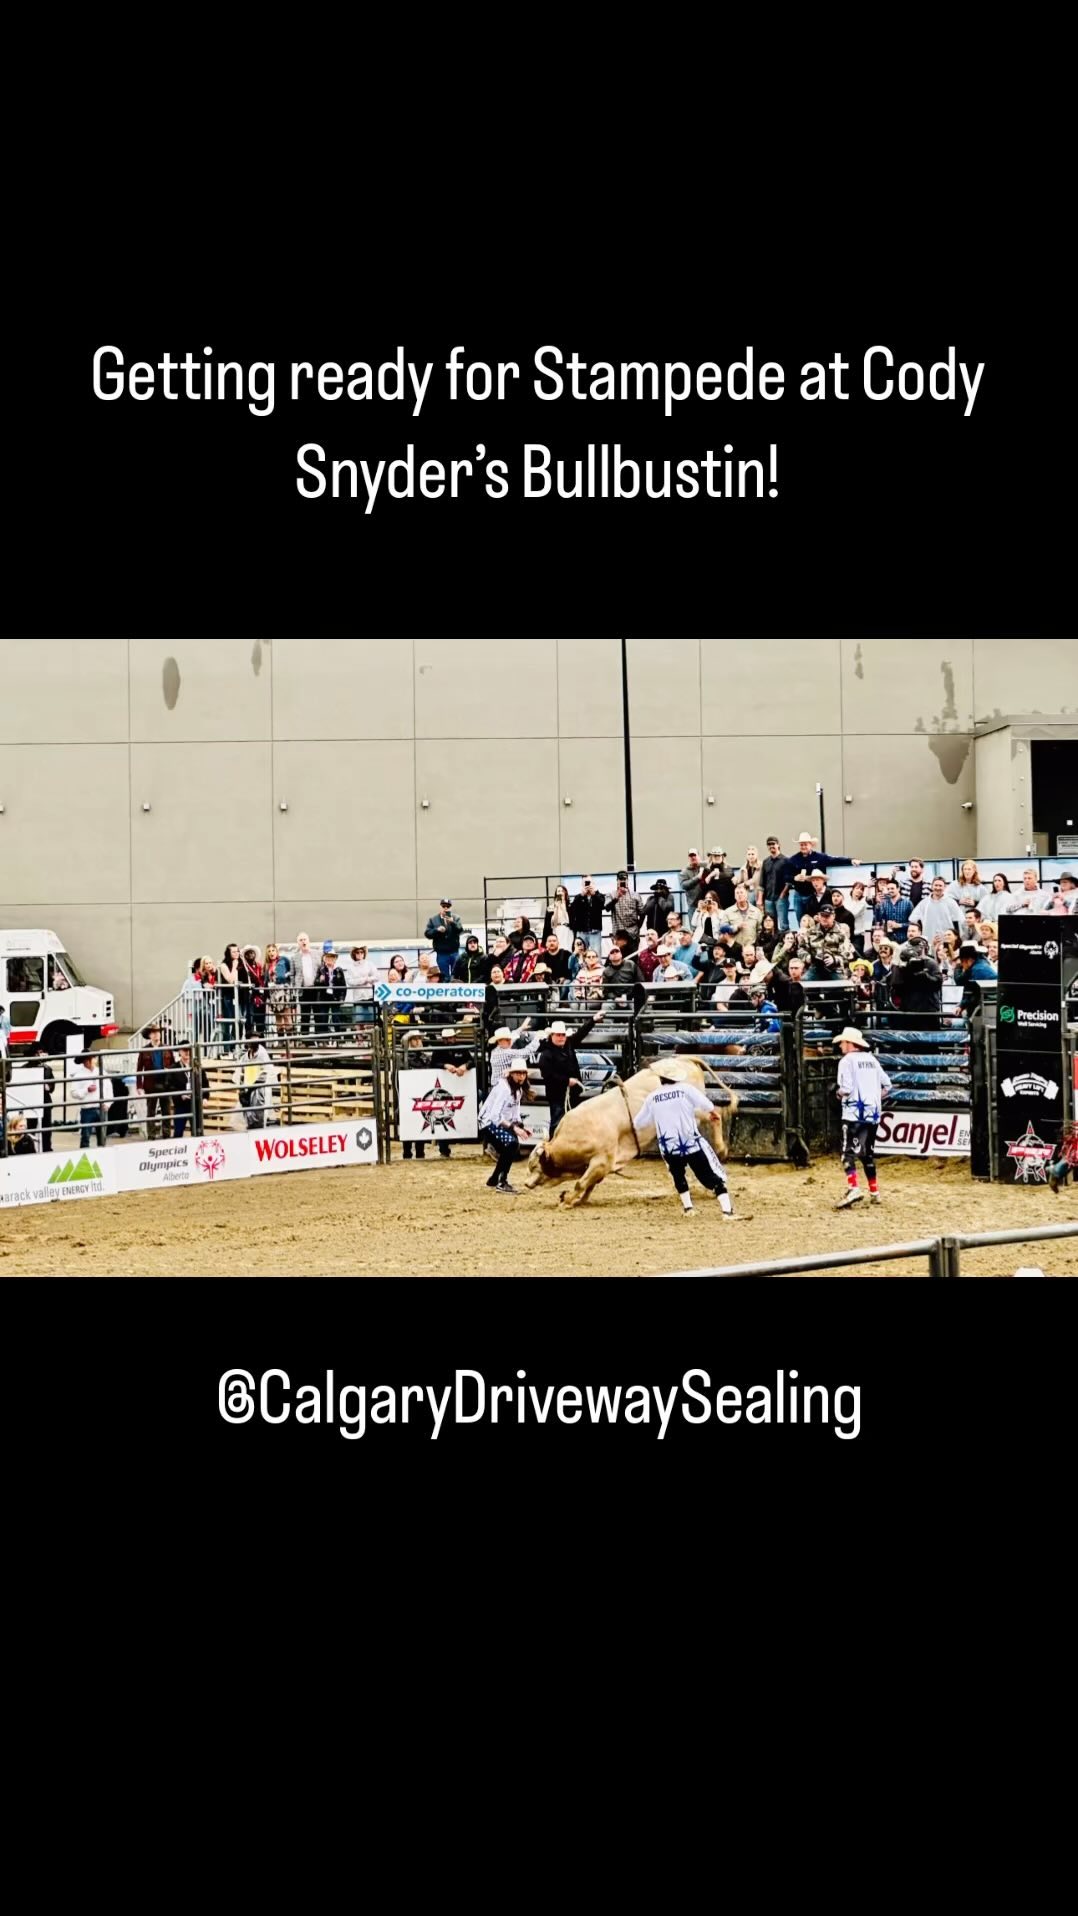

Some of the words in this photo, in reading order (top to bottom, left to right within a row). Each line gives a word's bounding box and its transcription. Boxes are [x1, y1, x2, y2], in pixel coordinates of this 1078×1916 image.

[396, 986, 485, 999] co-operators
[1017, 1010, 1059, 1021] Precision
[876, 1112, 958, 1153] Sanjel
[149, 1145, 187, 1158] Special
[255, 1134, 347, 1161] WOLSELEY
[139, 1159, 188, 1172] Olympics
[0, 1185, 31, 1203] arack
[33, 1184, 60, 1199] valley
[62, 1184, 89, 1196] ENERGY
